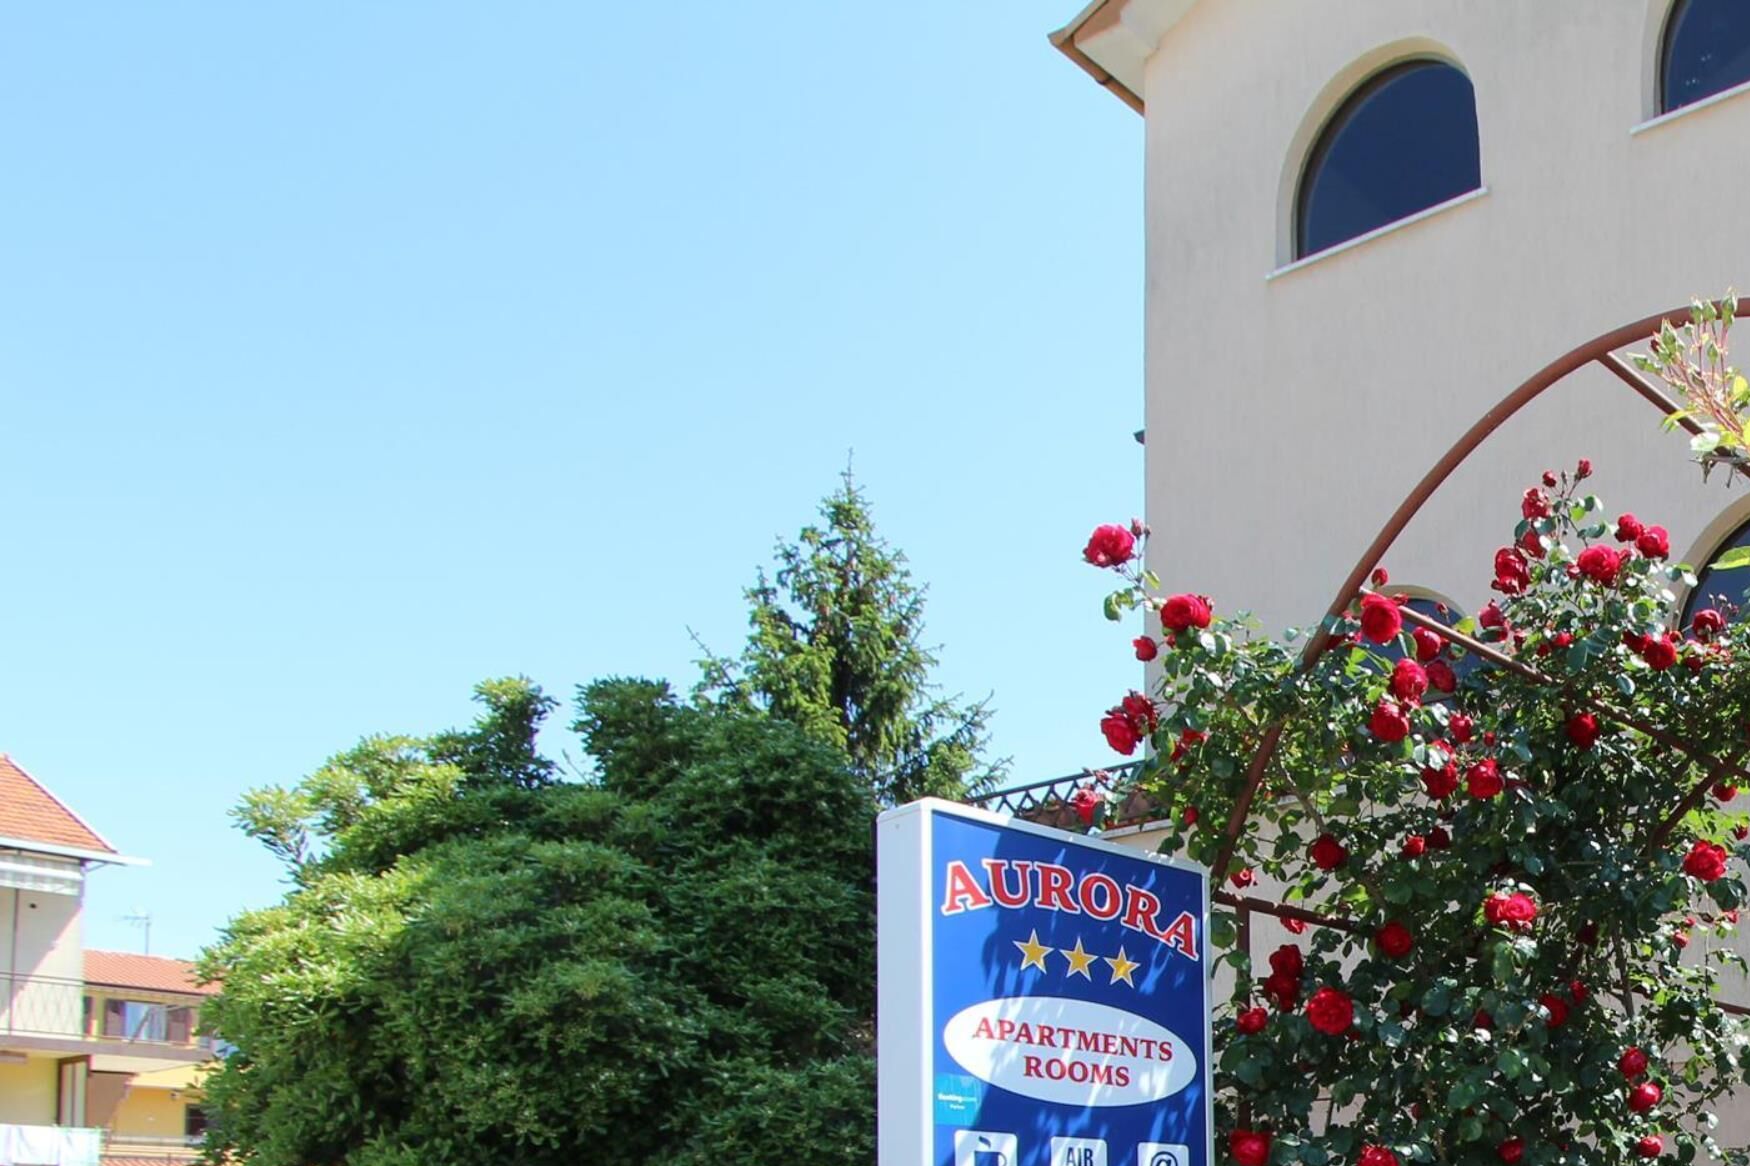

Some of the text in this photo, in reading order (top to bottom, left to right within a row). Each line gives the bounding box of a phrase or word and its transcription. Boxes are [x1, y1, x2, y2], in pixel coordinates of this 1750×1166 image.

[941, 859, 1199, 961] AURORA
[972, 1017, 1173, 1062] APARTMENTS
[1024, 1055, 1130, 1087] ROOMS
